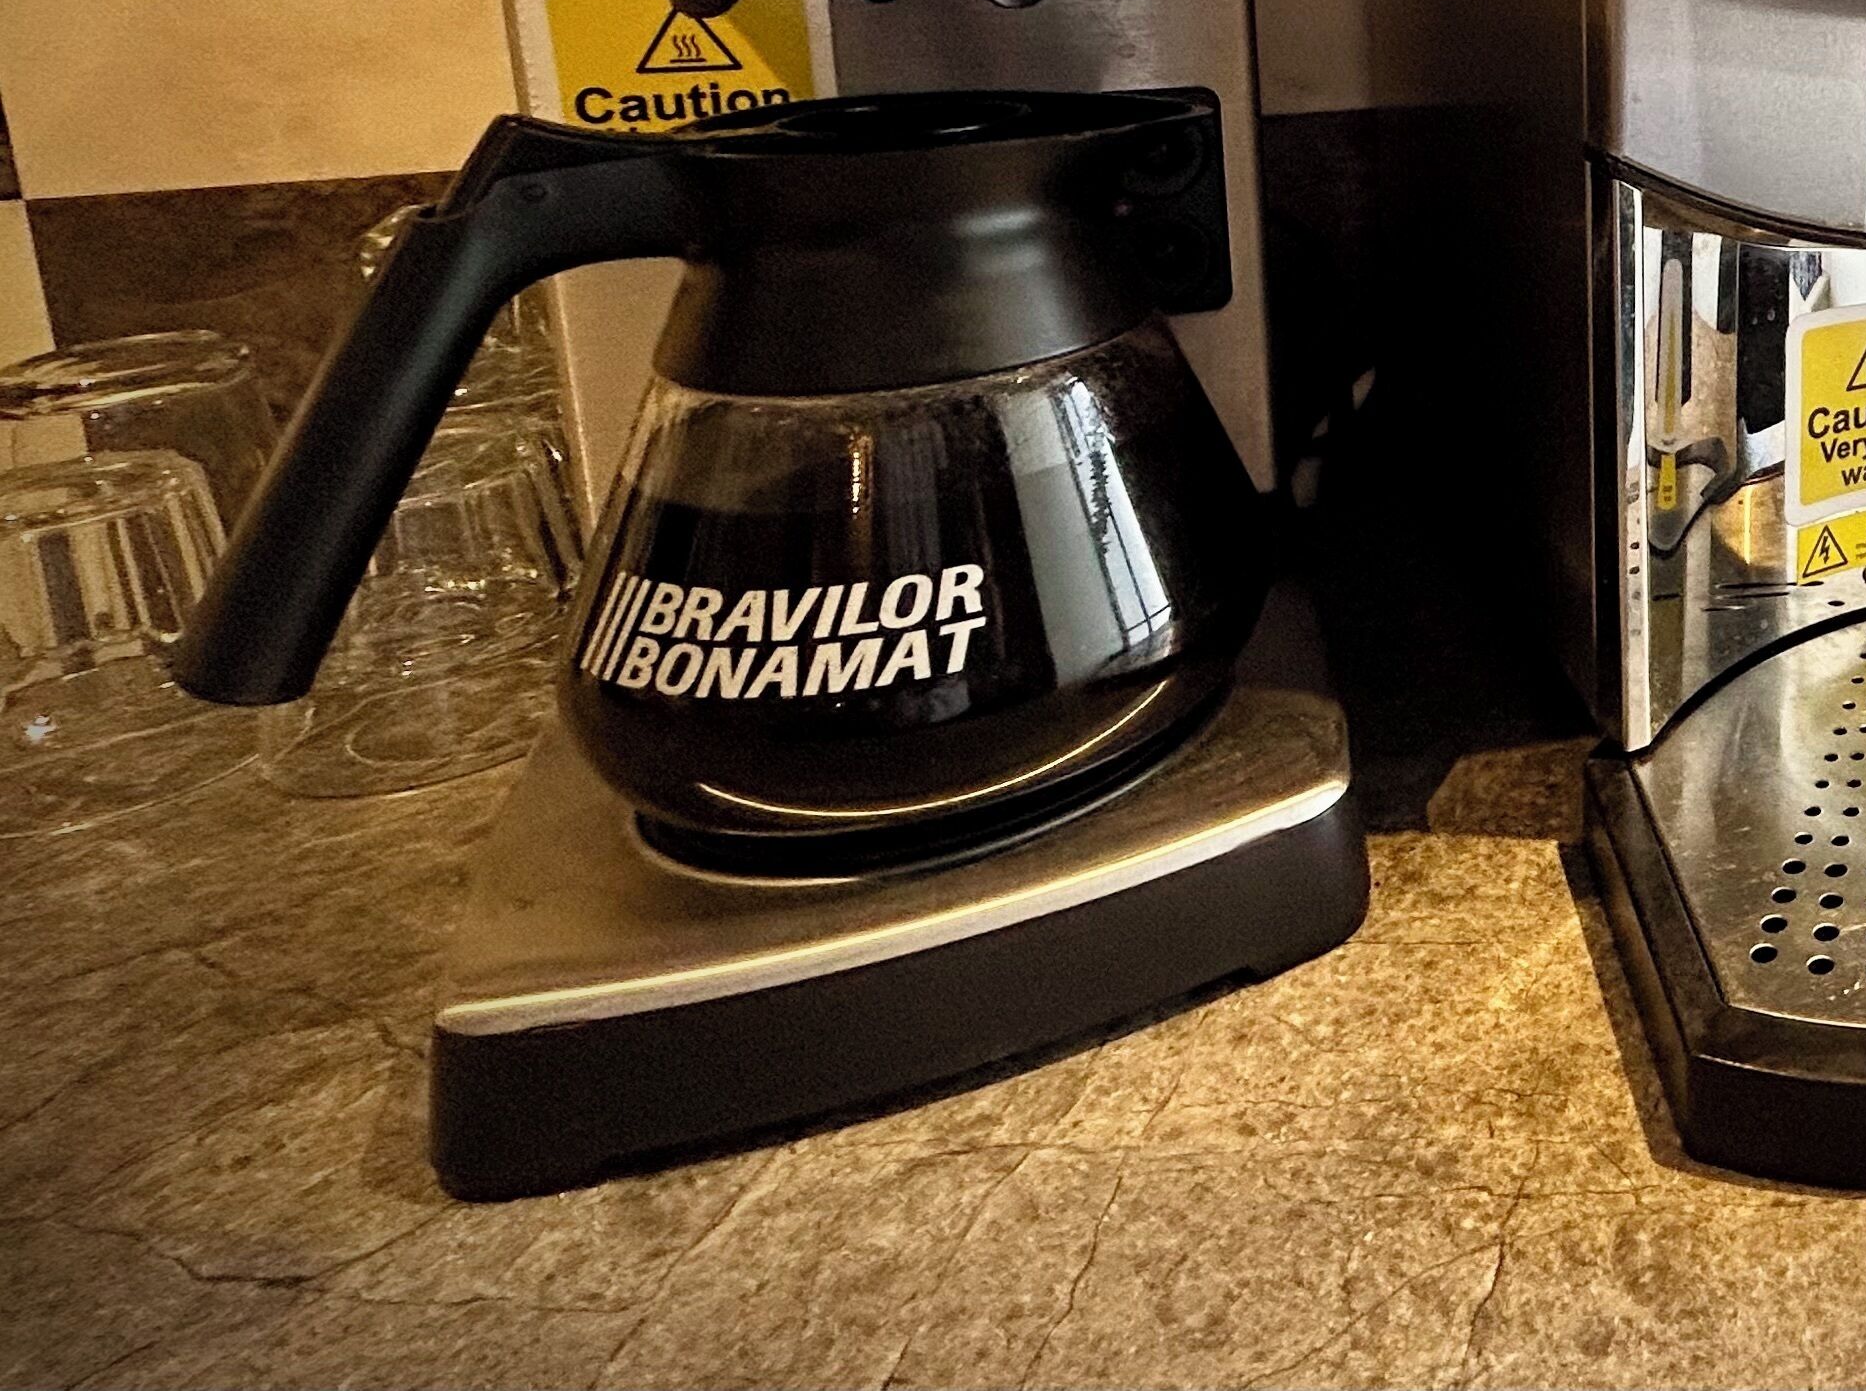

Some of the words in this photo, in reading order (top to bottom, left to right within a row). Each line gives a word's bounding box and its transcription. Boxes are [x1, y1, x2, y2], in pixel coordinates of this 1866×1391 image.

[575, 82, 791, 124] Caution
[639, 563, 985, 644] BRAVILOR
[622, 616, 987, 701] BONAMAT
